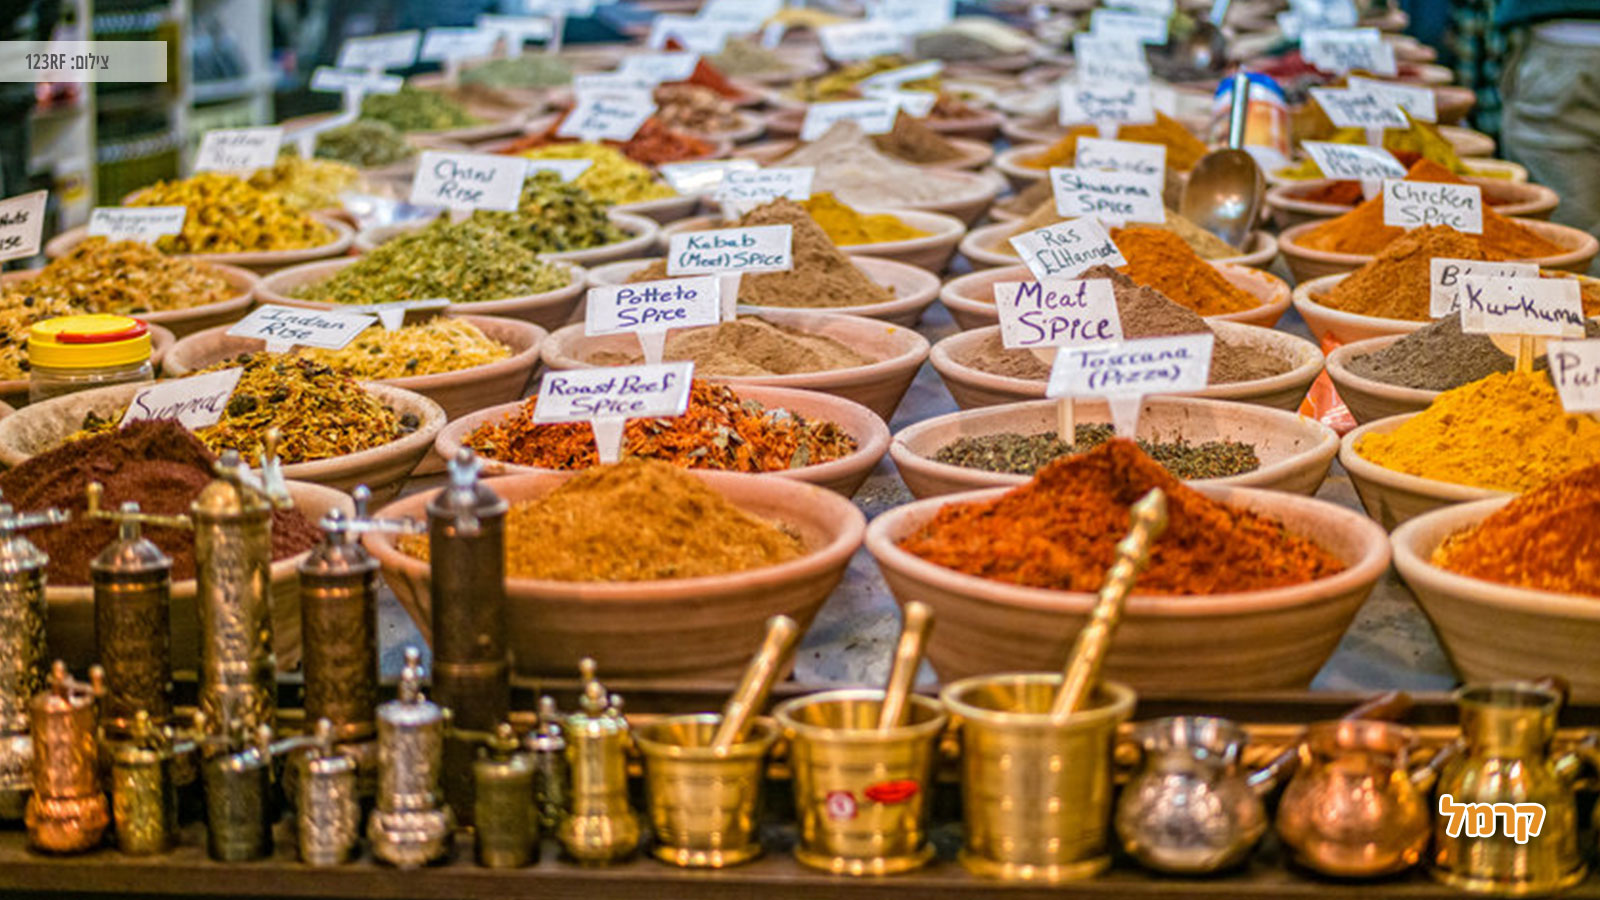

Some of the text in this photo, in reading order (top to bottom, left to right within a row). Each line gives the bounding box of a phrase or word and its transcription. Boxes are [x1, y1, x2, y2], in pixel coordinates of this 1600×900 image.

[1035, 228, 1082, 247] Ras
[1013, 281, 1089, 309] Meat
[548, 372, 677, 396] Roast Beef
